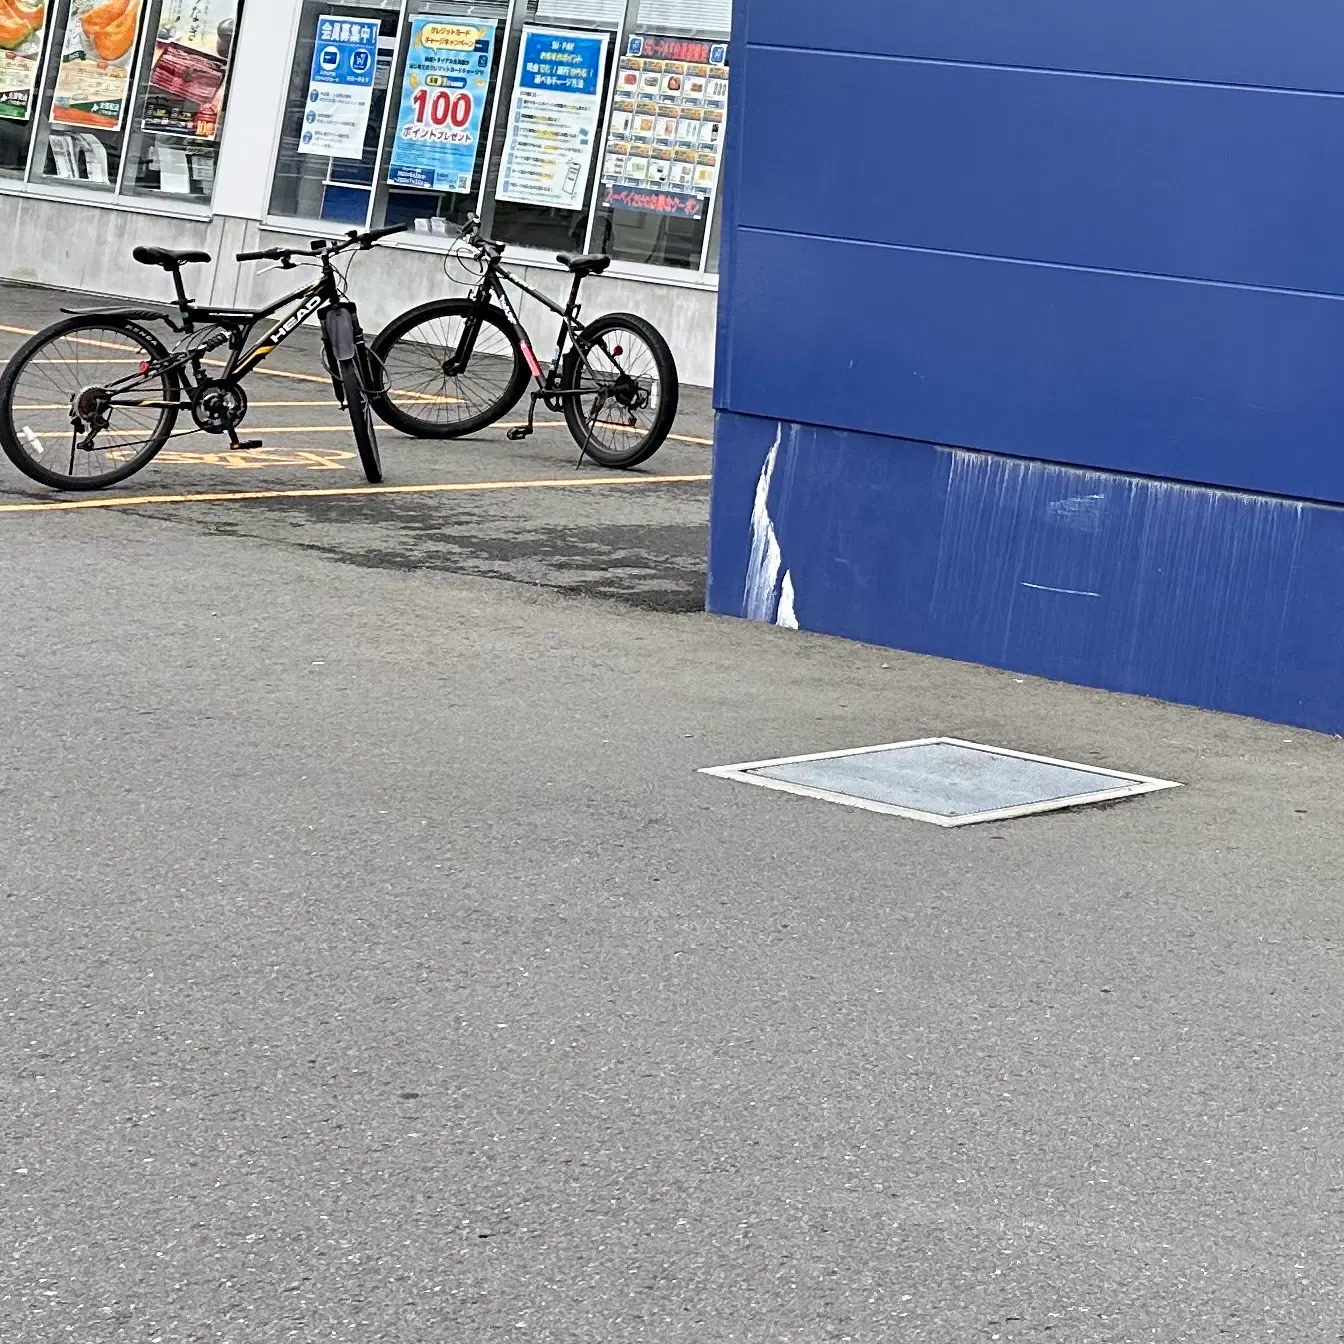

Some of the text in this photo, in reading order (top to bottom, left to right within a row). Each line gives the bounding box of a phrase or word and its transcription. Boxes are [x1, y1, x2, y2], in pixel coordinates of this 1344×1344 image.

[413, 89, 473, 128] 100
[402, 126, 473, 142] ポイントプレゼント
[270, 295, 322, 344] HEAD
